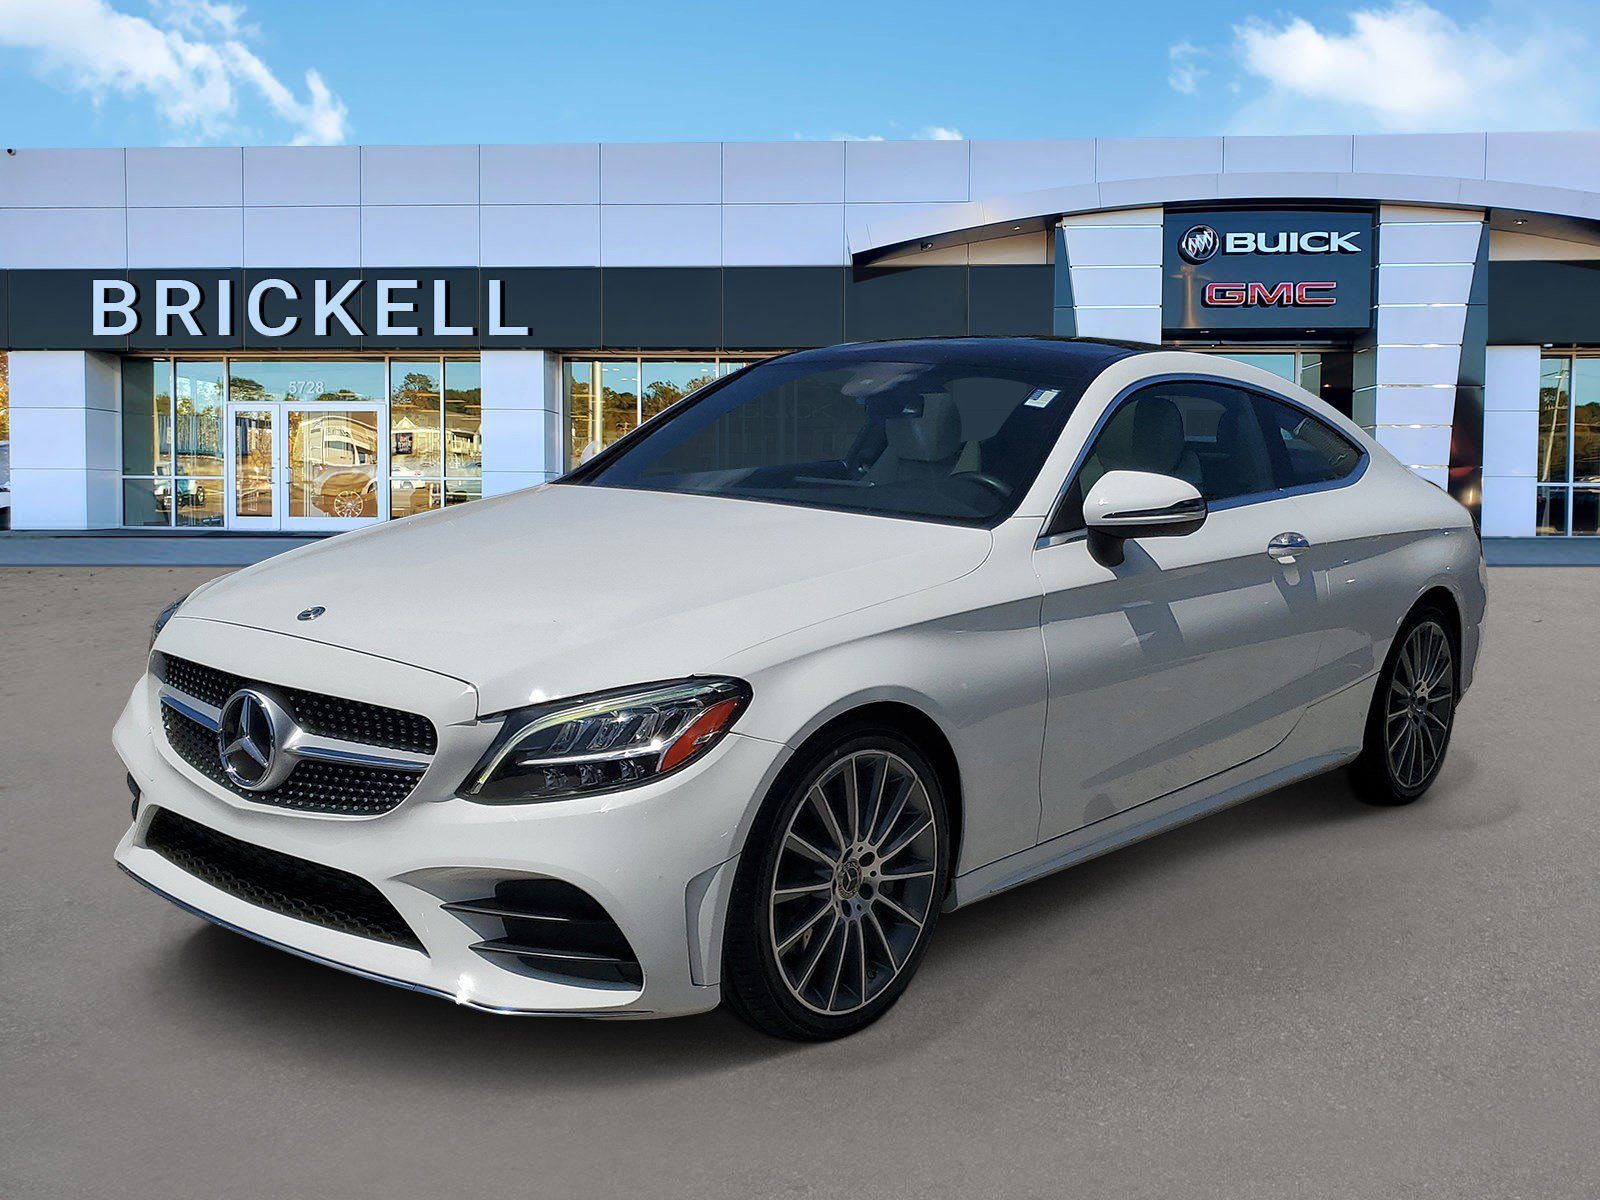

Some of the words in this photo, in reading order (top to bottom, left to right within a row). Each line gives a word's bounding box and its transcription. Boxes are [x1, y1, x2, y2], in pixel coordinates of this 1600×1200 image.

[1225, 231, 1361, 253] BUICK
[1205, 281, 1337, 305] GMC
[92, 278, 531, 337] BRICKELL
[289, 380, 325, 394] 5728
